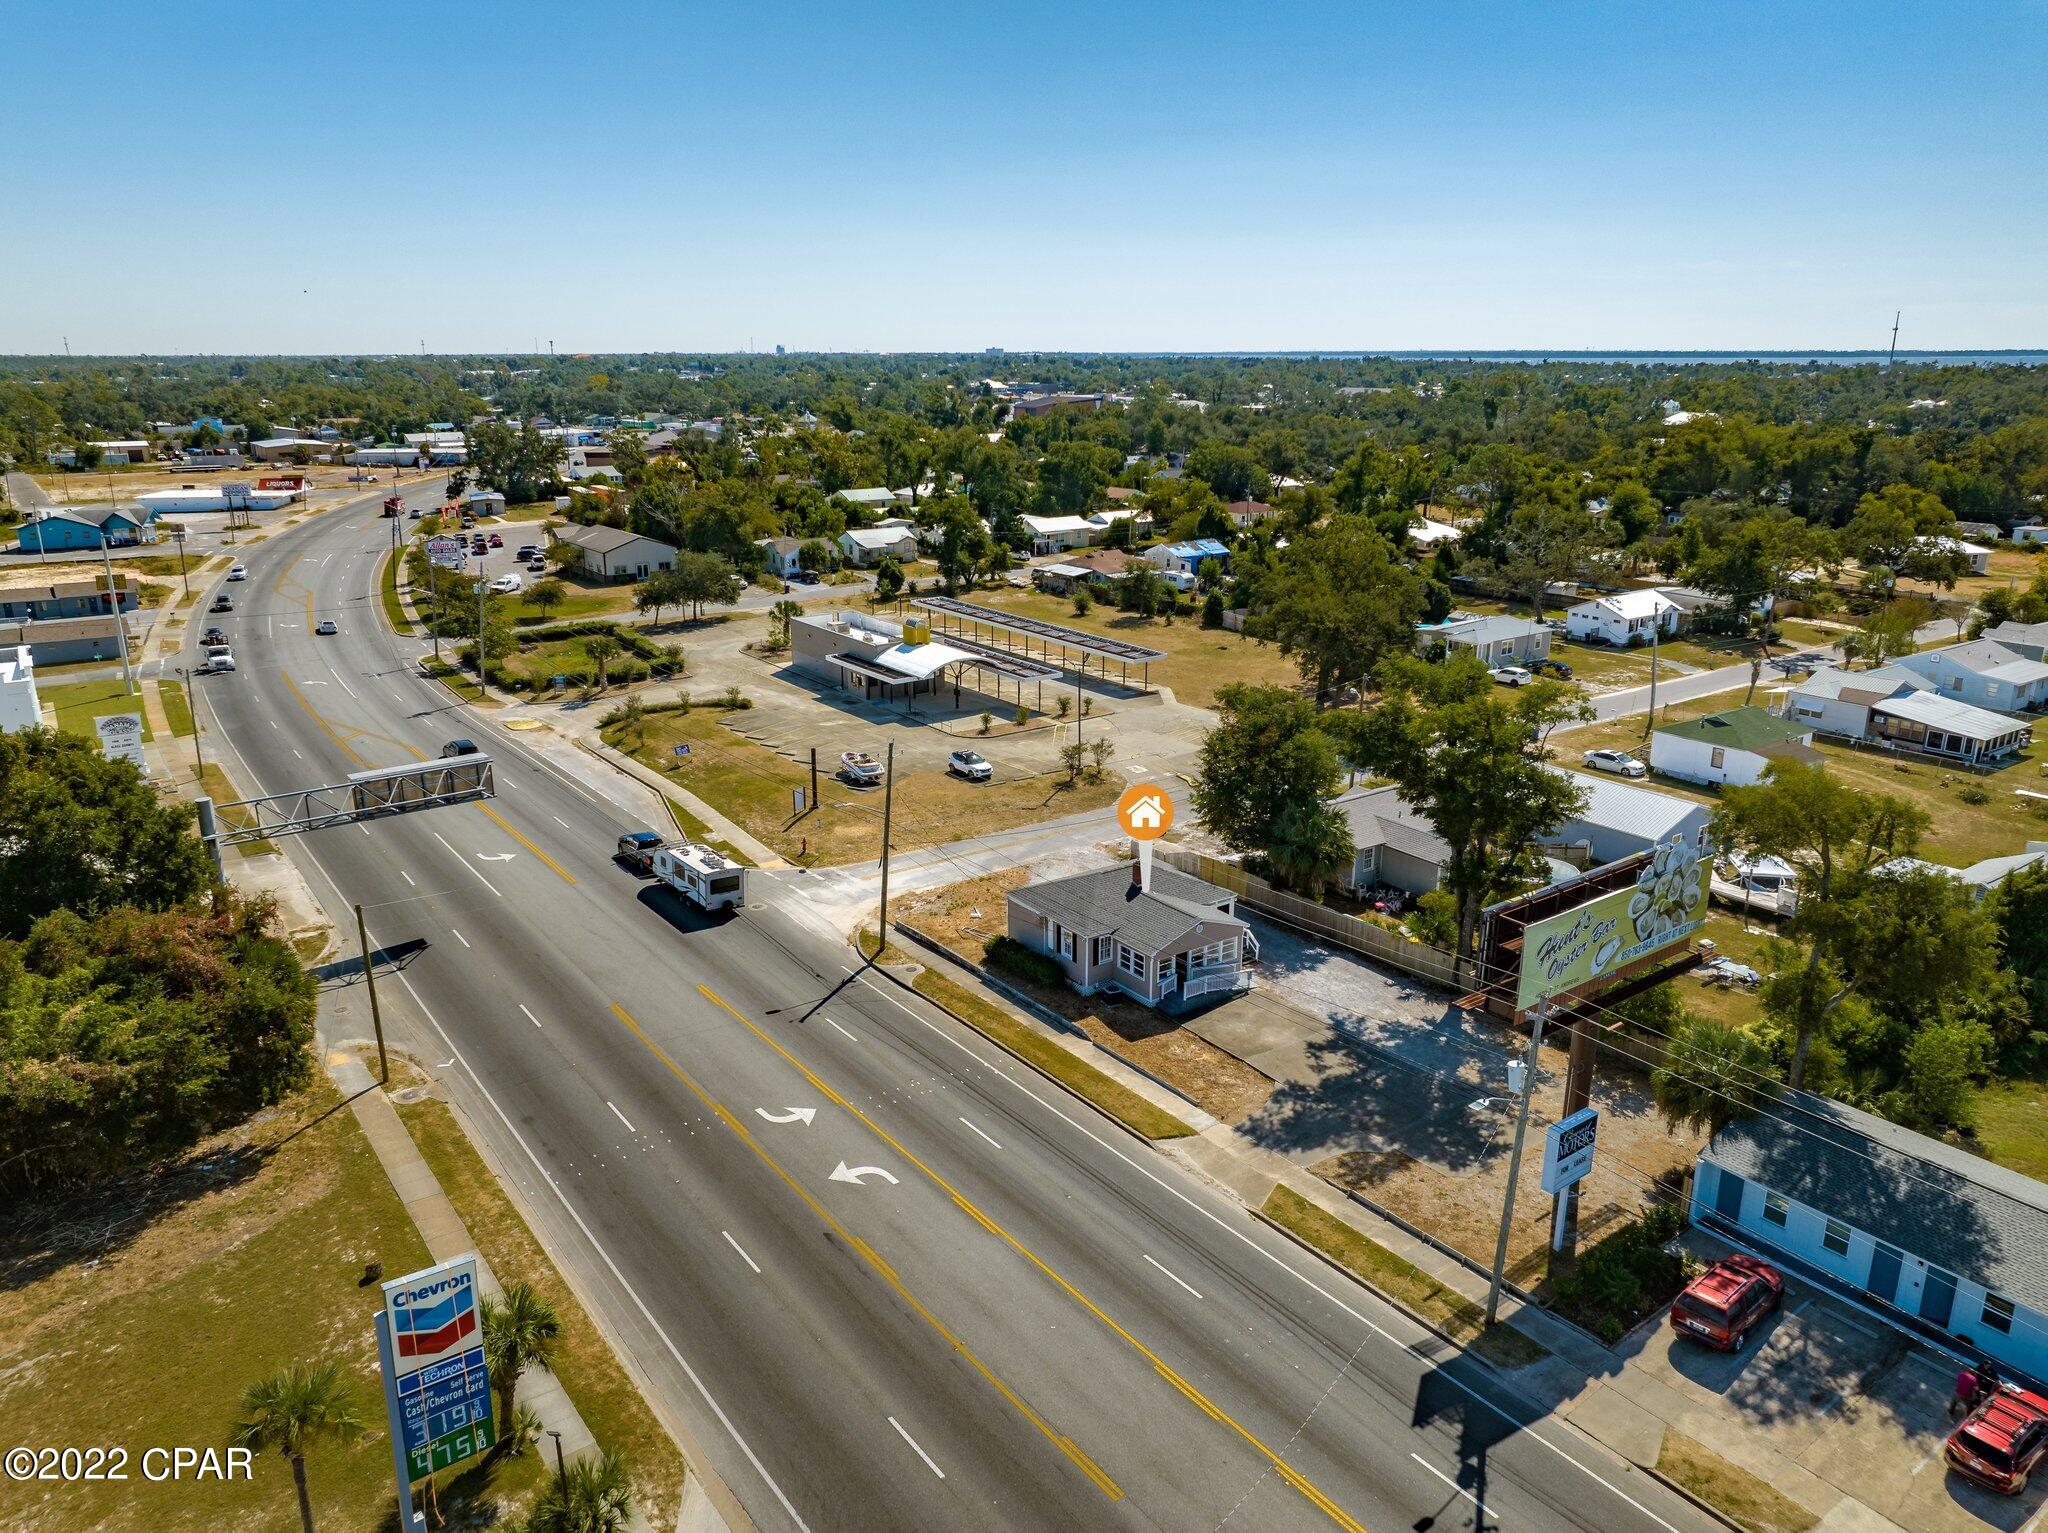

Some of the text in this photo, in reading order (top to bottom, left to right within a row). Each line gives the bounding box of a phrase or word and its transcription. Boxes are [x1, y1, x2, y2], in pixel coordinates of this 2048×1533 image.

[1536, 909, 1594, 967] Hunt's
[1547, 916, 1618, 981] Oyster Bar
[1557, 1127, 1596, 1159] MOTORS
[392, 1271, 471, 1308] Chevron
[418, 1361, 465, 1384] TECHRON
[450, 1377, 463, 1390] Self
[405, 1390, 434, 1407] Gasoine
[465, 1379, 484, 1394] Card
